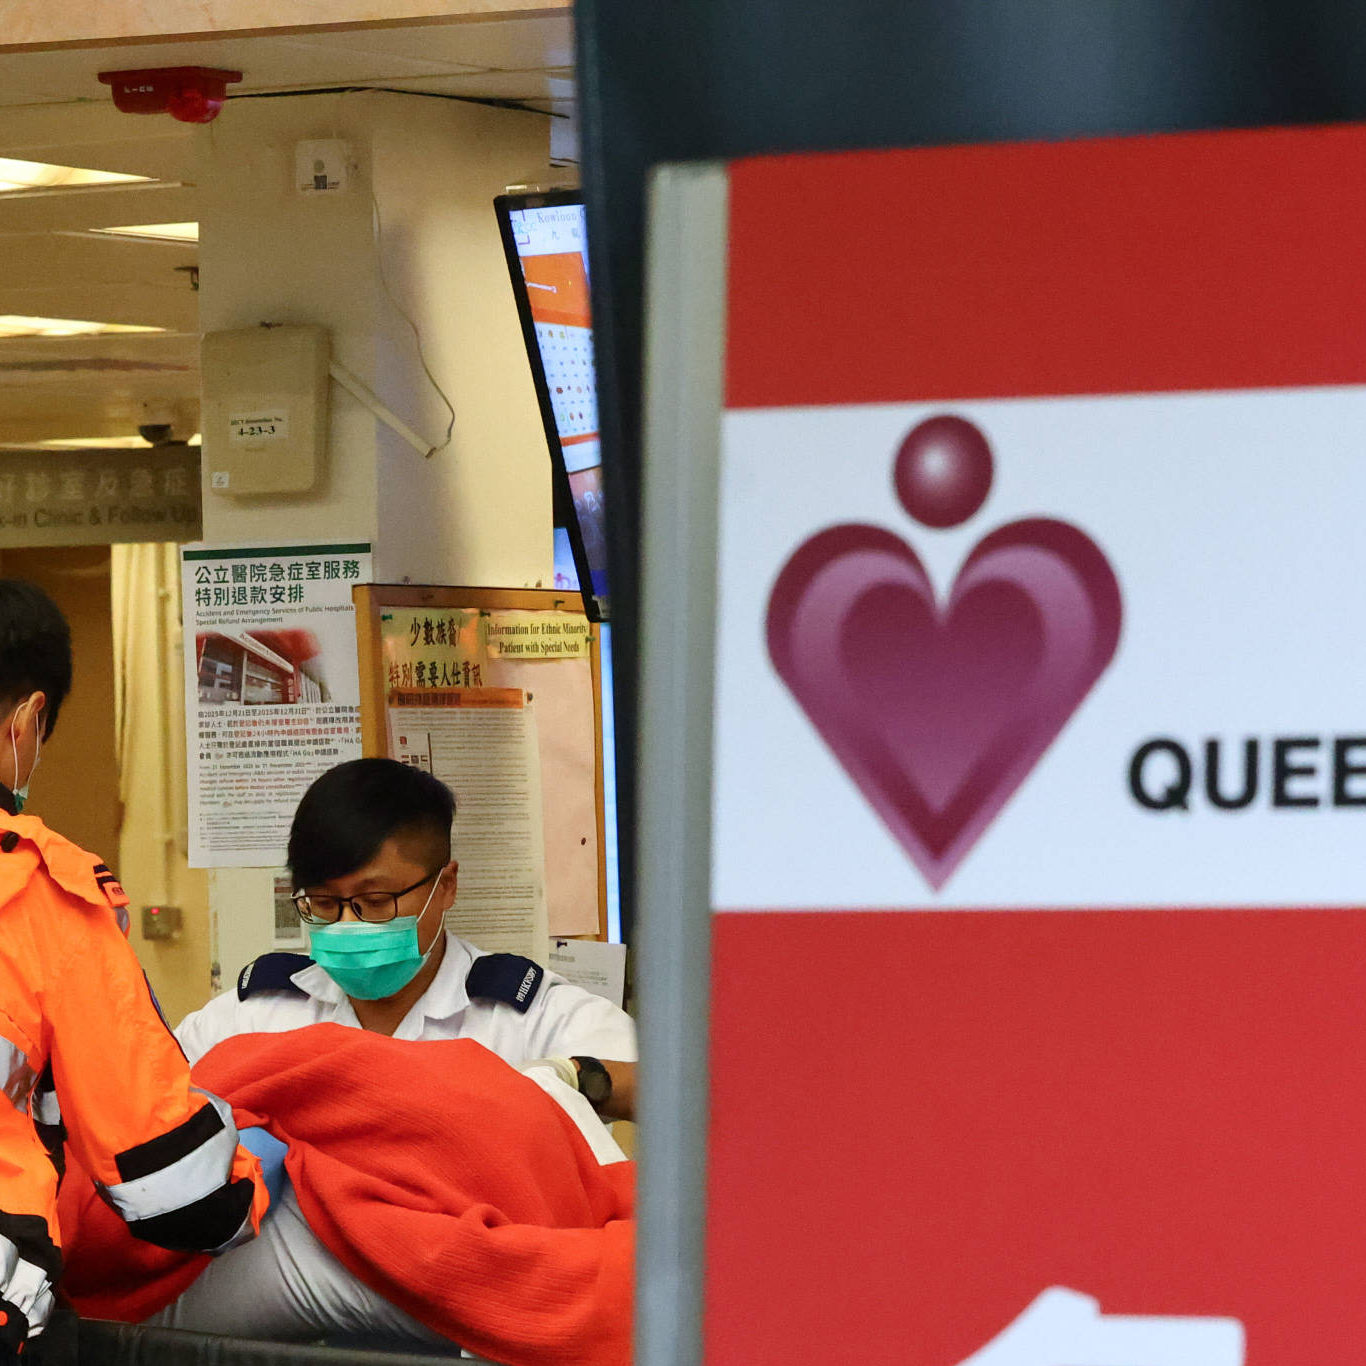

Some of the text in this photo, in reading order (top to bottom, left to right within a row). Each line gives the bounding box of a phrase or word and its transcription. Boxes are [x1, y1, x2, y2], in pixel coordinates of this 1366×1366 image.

[195, 560, 360, 584] 公立醫院急症室服務
[195, 584, 304, 607] 特別退款安排
[487, 622, 528, 636] Information
[530, 622, 540, 636] for
[541, 622, 561, 635] Ethnic
[499, 641, 524, 654] Patient
[525, 641, 539, 653] with
[540, 641, 563, 655] Special
